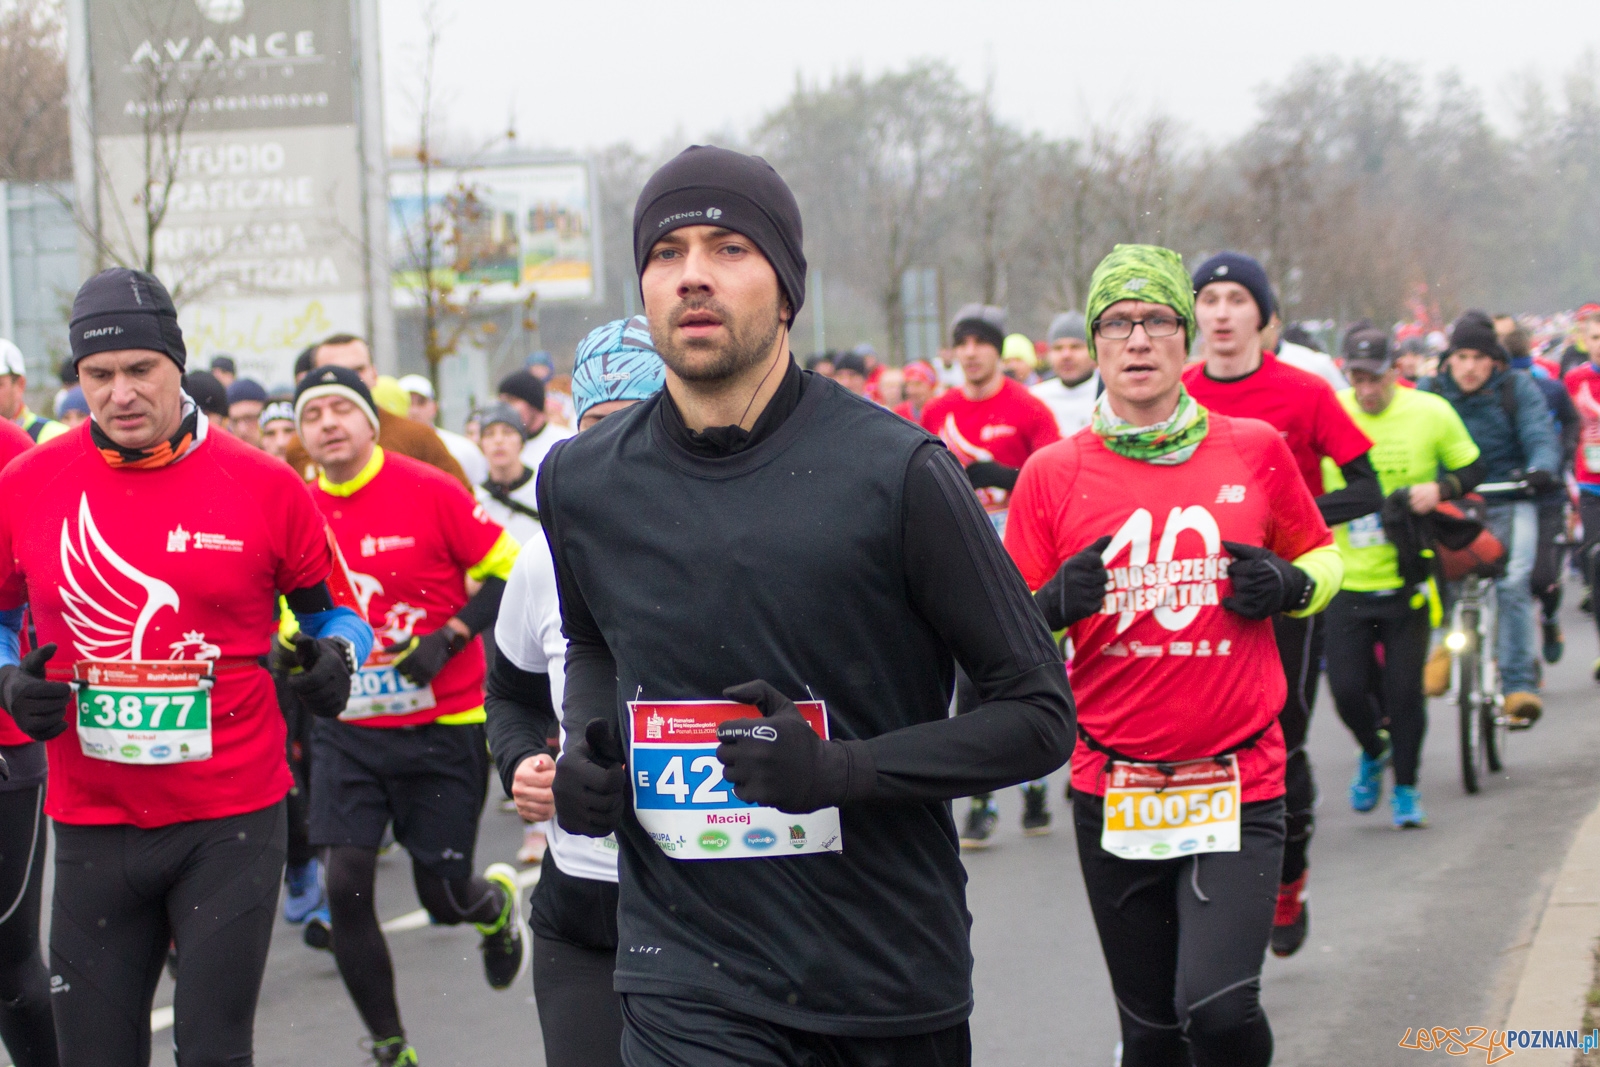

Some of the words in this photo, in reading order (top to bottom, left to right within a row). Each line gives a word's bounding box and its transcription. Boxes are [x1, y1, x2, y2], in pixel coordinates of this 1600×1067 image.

[130, 30, 316, 65] AVANCE
[658, 210, 703, 228] ARTENGO
[83, 327, 114, 339] CRAFT
[94, 694, 195, 728] 3877
[637, 771, 650, 787] E
[656, 756, 738, 804] 42
[706, 813, 751, 825] Maciej
[1117, 791, 1233, 828] 10050
